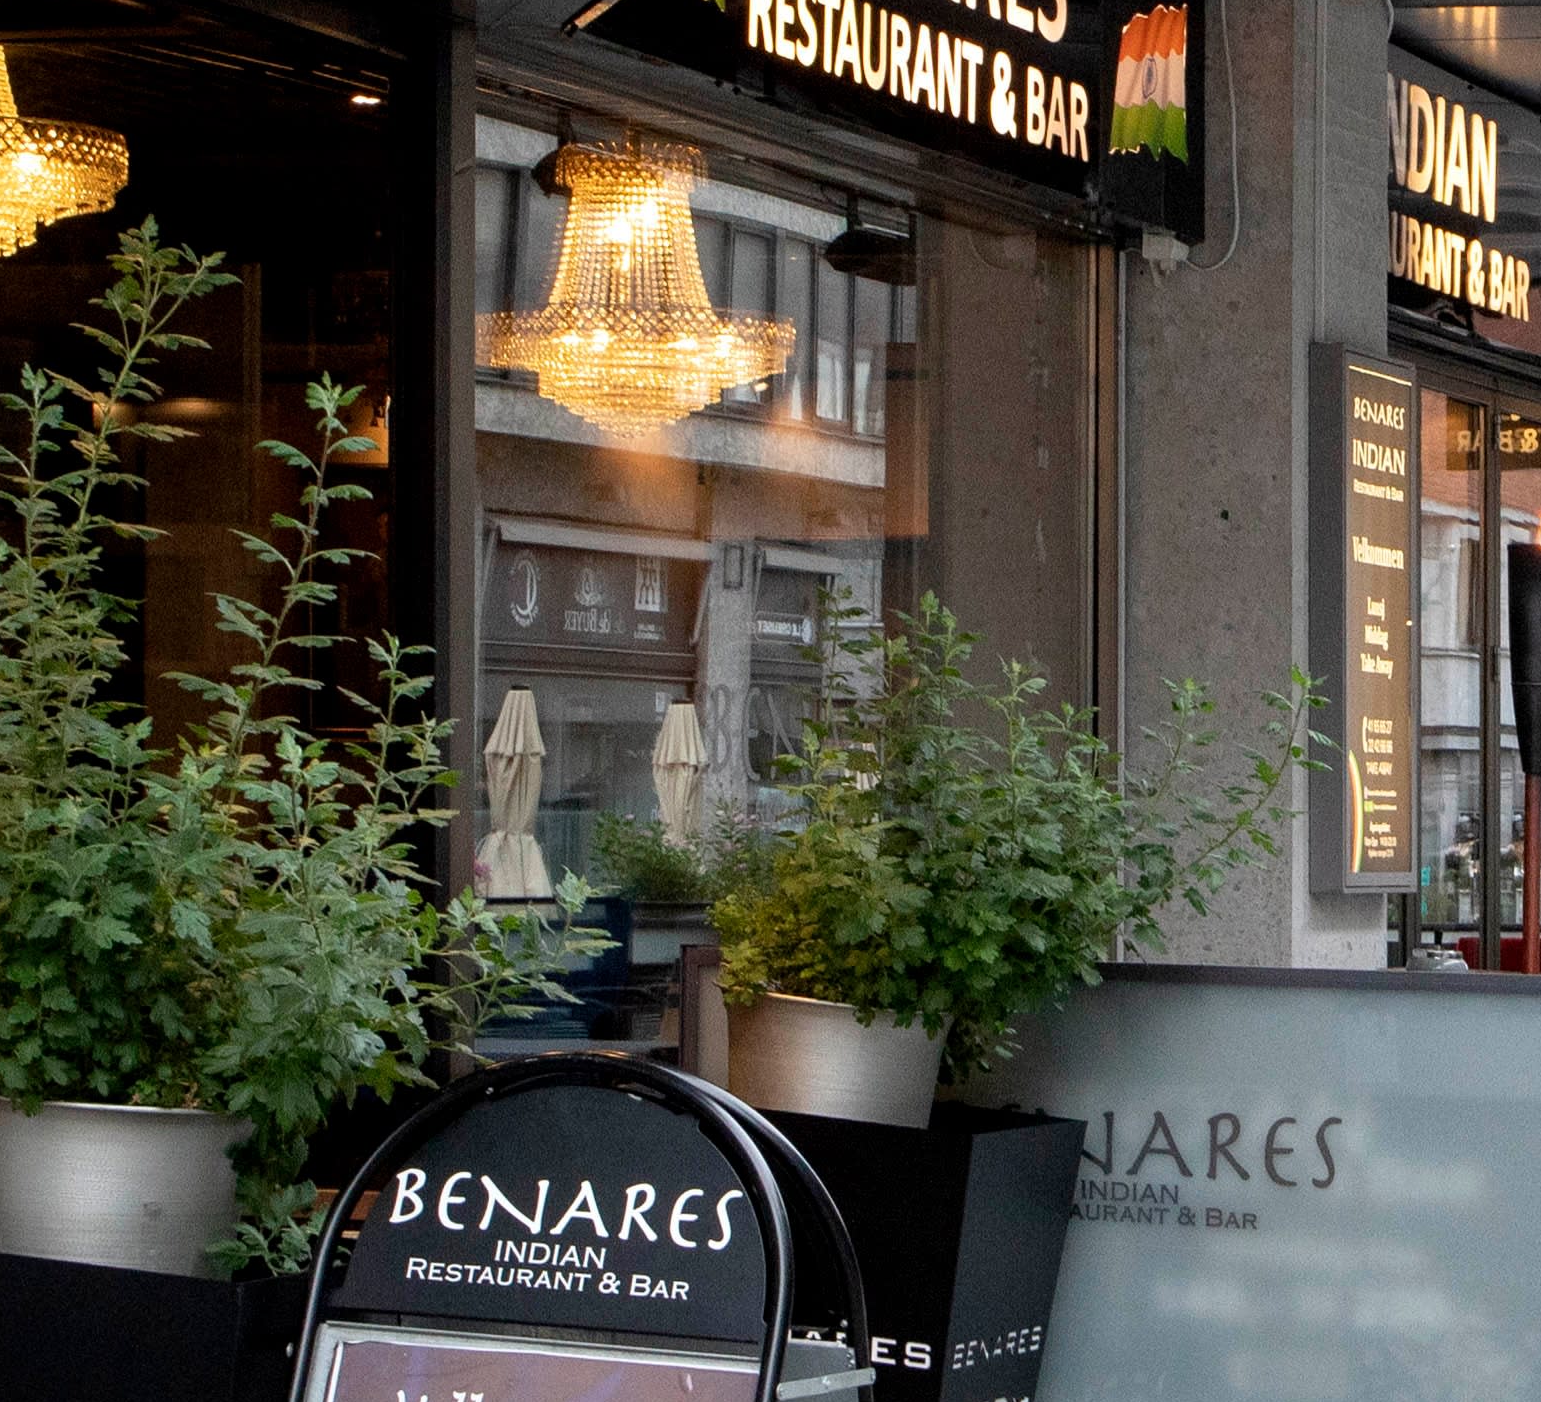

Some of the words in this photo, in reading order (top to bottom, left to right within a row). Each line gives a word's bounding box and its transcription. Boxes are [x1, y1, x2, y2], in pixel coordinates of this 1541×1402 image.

[990, 50, 1017, 139] &
[1026, 65, 1090, 163] BAR
[1388, 72, 1498, 224] NDIAN
[1388, 210, 1465, 298] URANT
[1466, 239, 1485, 308] &
[1489, 249, 1530, 323] BAR
[1353, 396, 1405, 431] BENARES
[1352, 439, 1406, 477] INDIAN
[1352, 536, 1405, 570] Velkommen
[1081, 1110, 1343, 1190] NARES
[388, 1167, 744, 1252] BENARES
[1079, 1178, 1181, 1206] INDIAN
[1176, 1206, 1197, 1227] &
[1205, 1208, 1258, 1230] BAR
[495, 1238, 608, 1271] INDIAN
[405, 1256, 594, 1293] RESTAURANT
[597, 1271, 621, 1295] &
[628, 1275, 690, 1301] BAR
